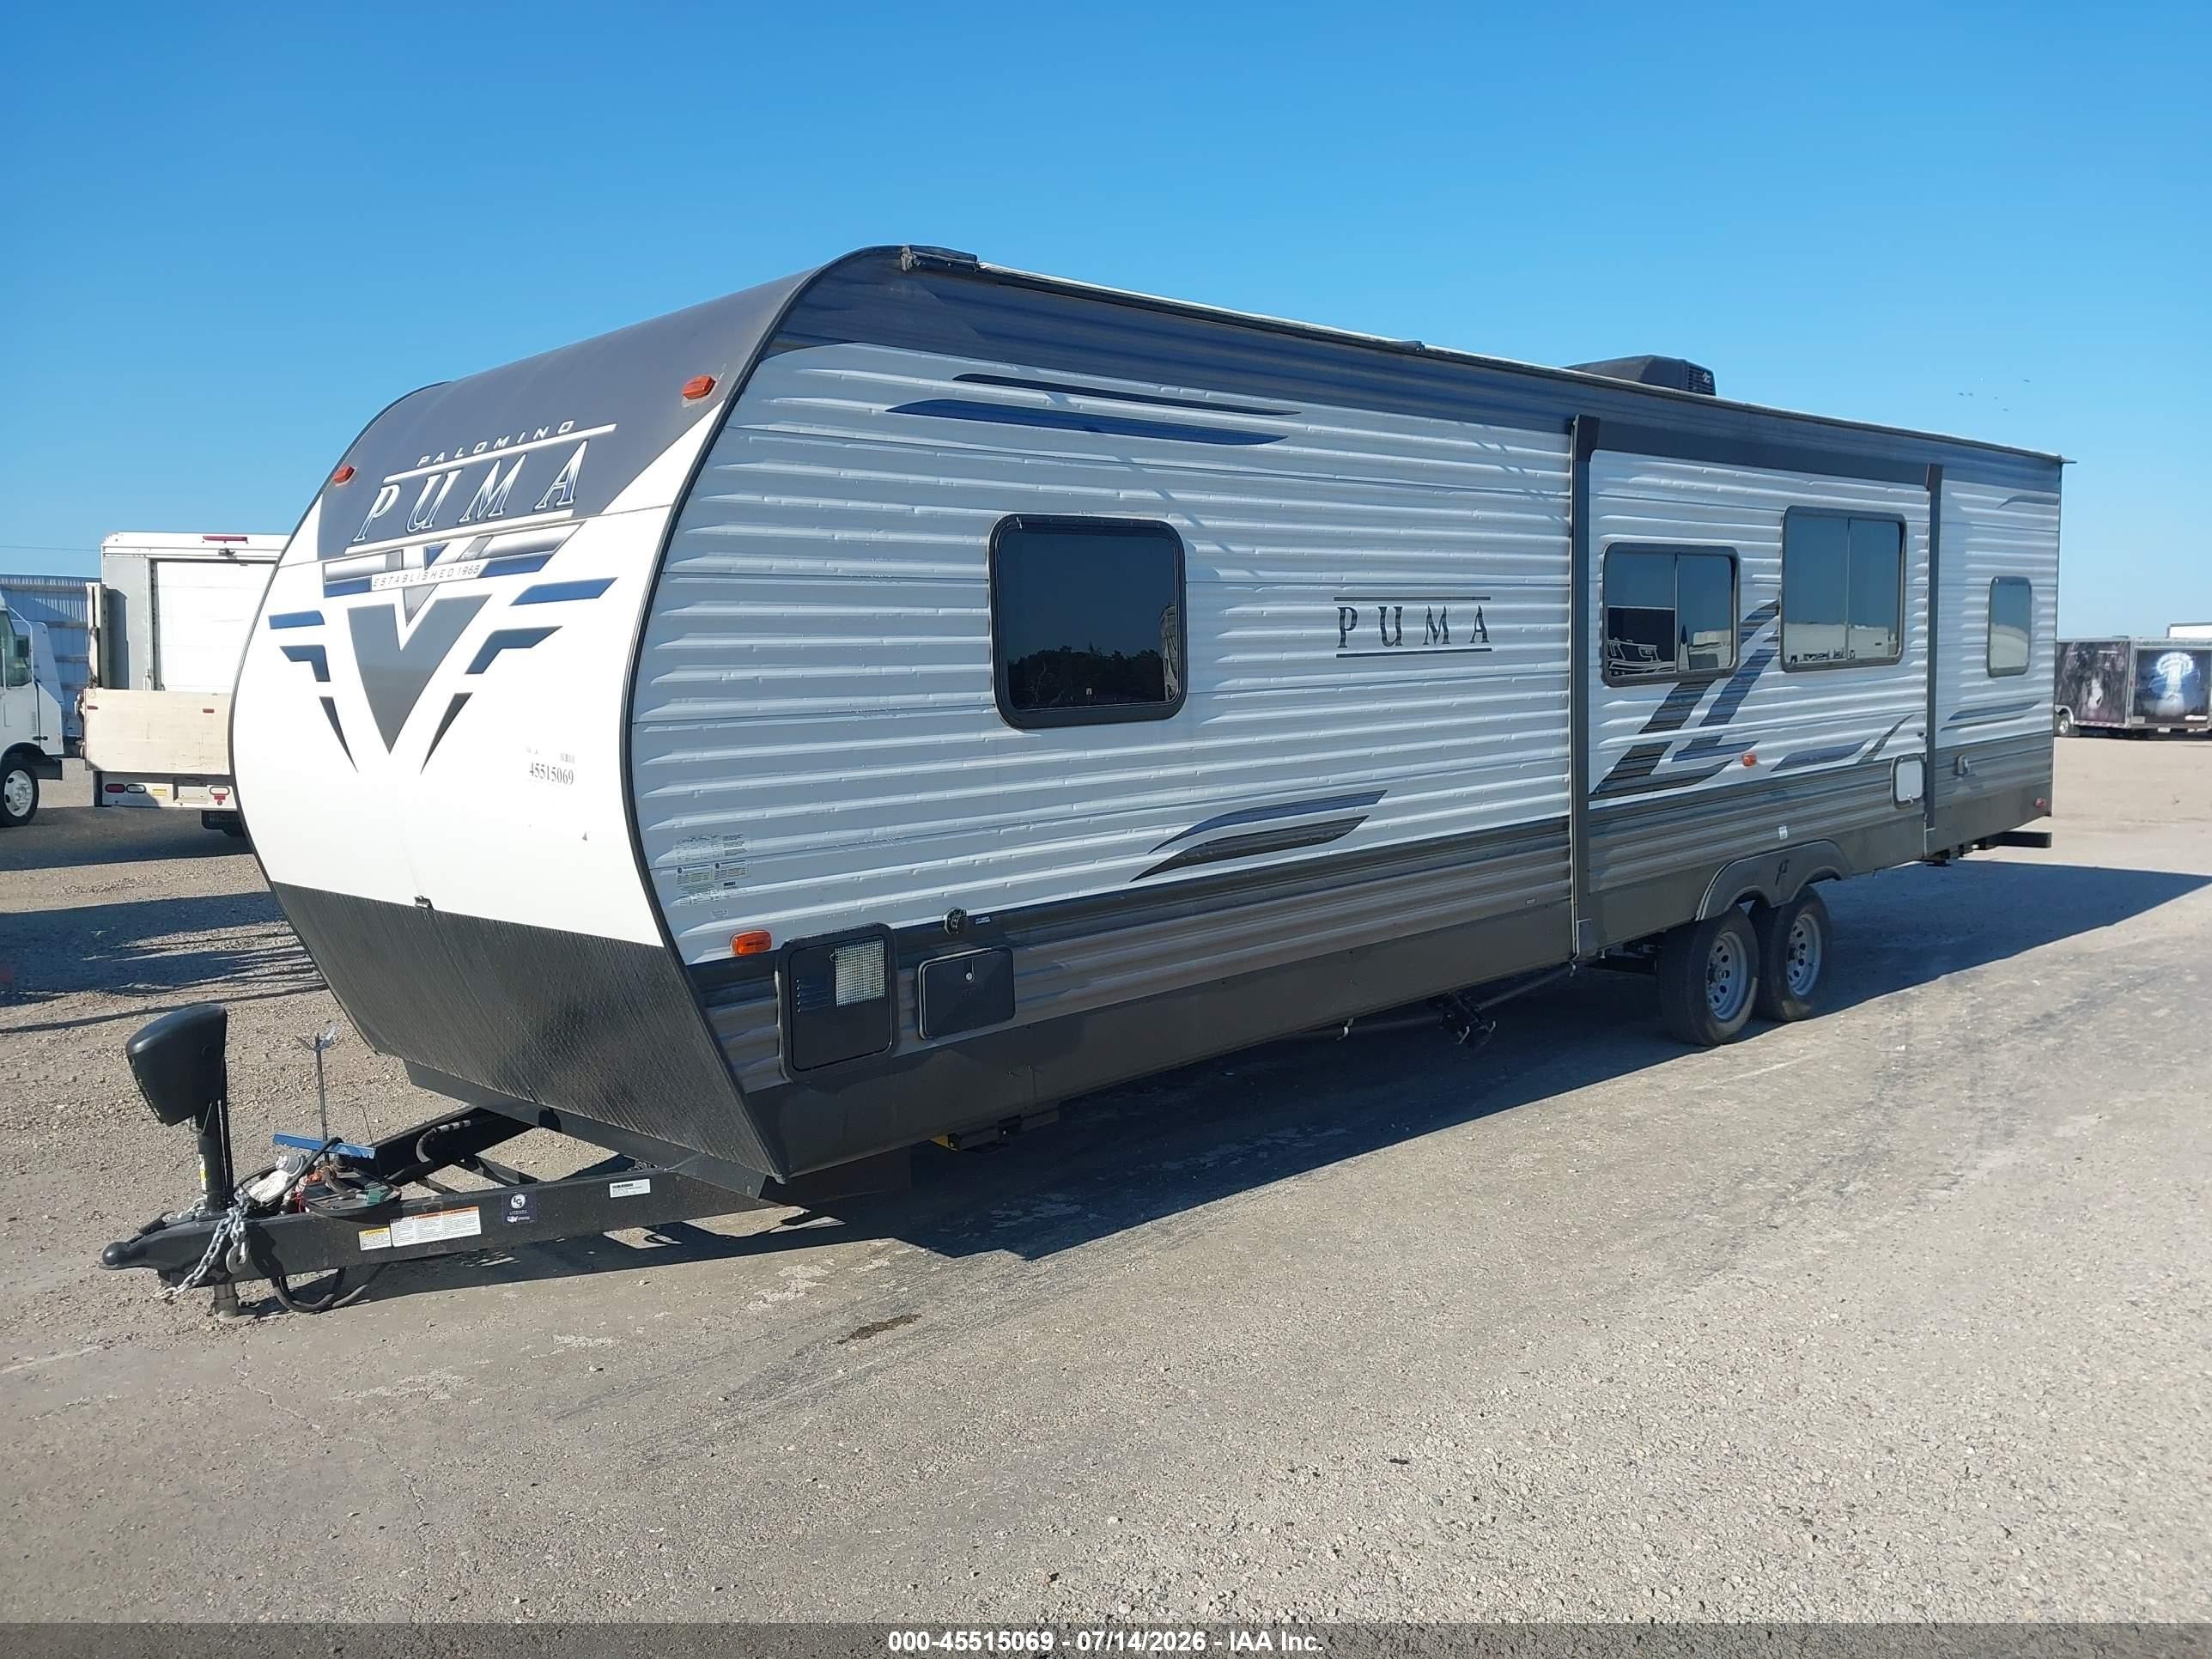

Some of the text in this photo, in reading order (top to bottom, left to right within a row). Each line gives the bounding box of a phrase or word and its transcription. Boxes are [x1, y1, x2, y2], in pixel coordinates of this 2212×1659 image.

[416, 420, 576, 467] PALOMINO
[352, 440, 588, 543] PUMA
[373, 564, 481, 587] ESTABLISHED 1968
[1337, 605, 1490, 648] PUMA
[529, 762, 574, 786] 45515069
